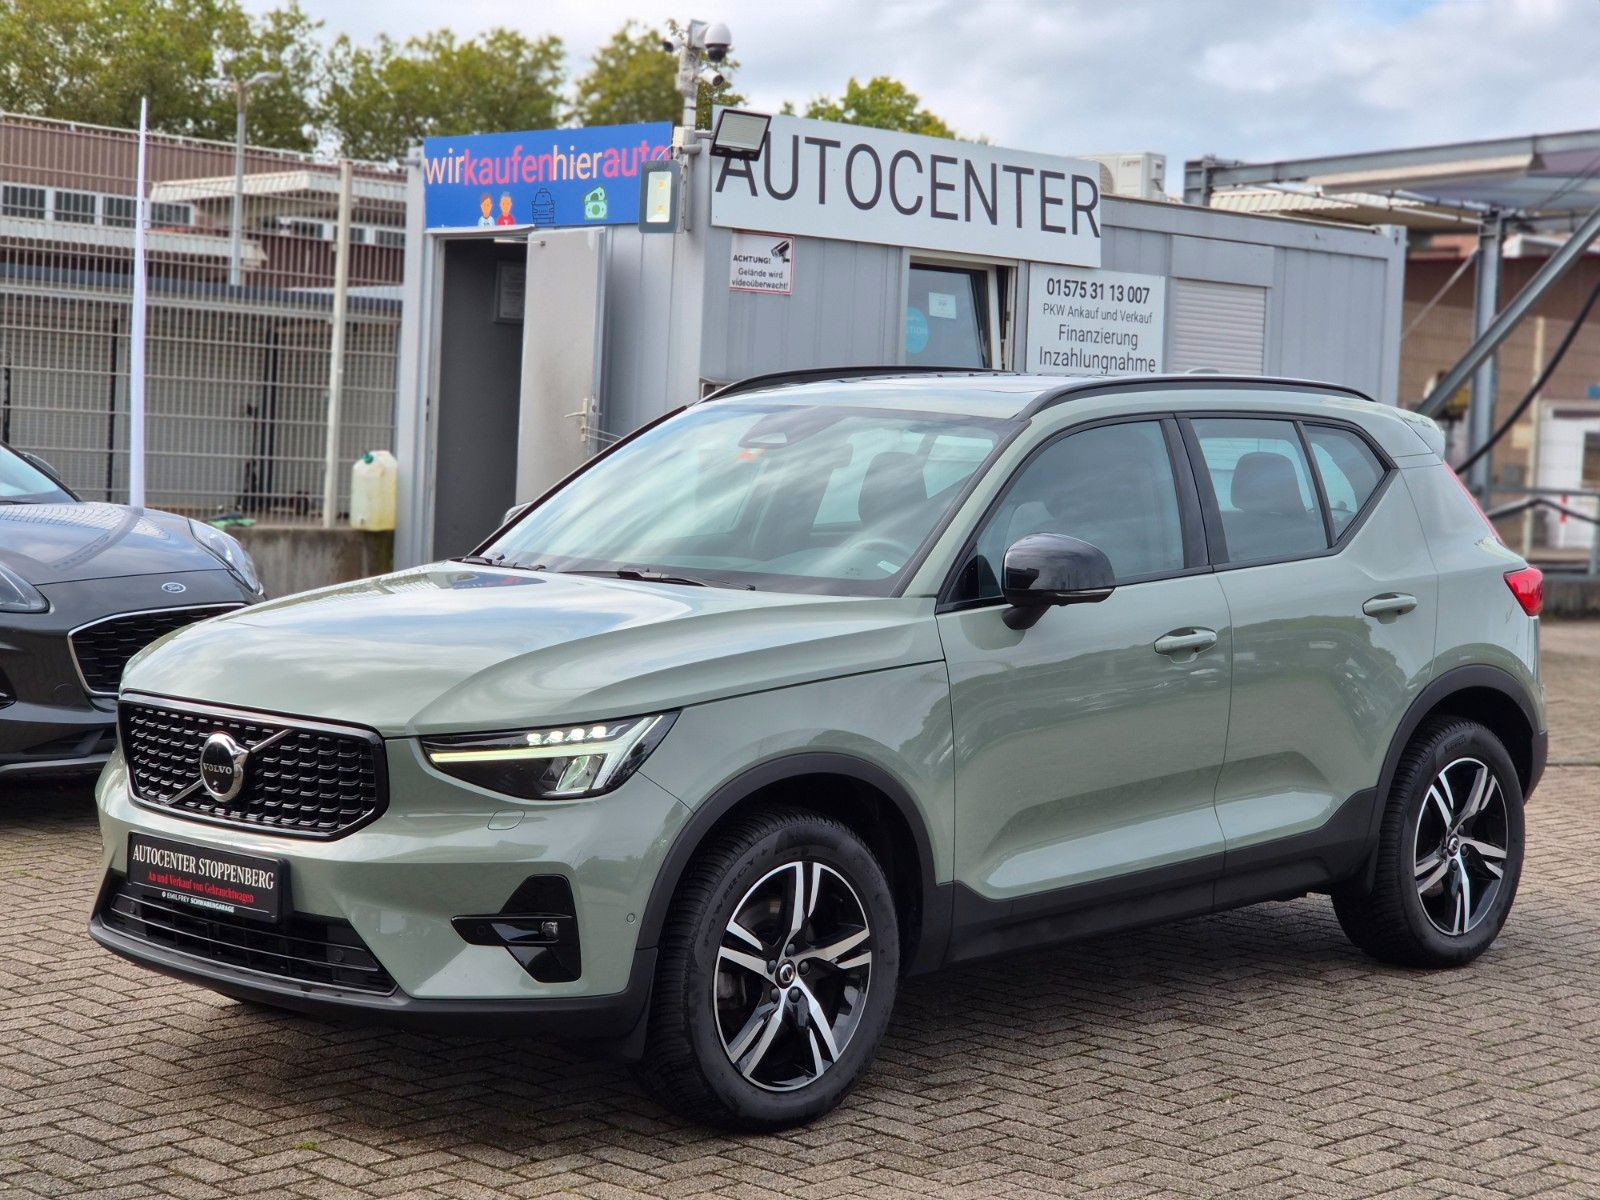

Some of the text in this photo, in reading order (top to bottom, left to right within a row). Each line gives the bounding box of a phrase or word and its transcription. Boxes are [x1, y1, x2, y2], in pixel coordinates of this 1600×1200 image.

[715, 131, 1100, 238] AUTOCENTER
[733, 255, 771, 264] ACHTUNG!
[732, 279, 788, 289] videoüberwacht!
[738, 268, 767, 277] Gelände
[1047, 278, 1150, 304] 01575 31 13 007
[1043, 303, 1153, 324] PKW Ankauf und Verkauf
[1058, 324, 1138, 350] Finanzierung
[1040, 346, 1156, 374] Inzahlungnahme
[202, 762, 233, 775] VOLVO
[132, 844, 274, 890] AUTOCENTER STOPPENBERG
